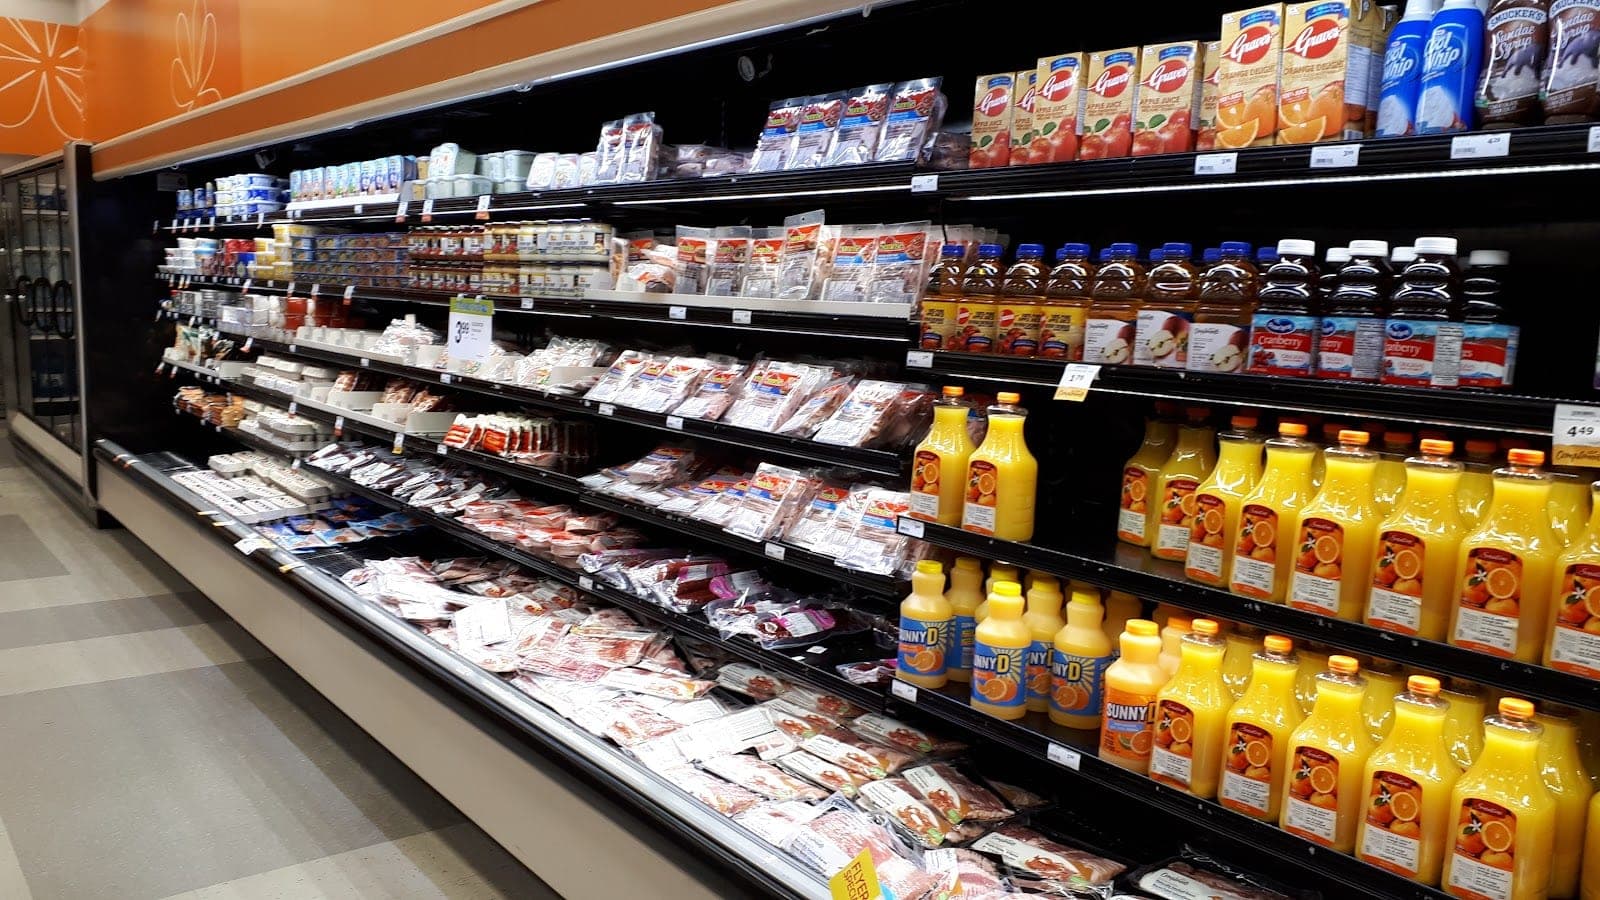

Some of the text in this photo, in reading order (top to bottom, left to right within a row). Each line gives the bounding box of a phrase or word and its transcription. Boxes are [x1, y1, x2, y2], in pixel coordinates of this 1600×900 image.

[1495, 23, 1537, 44] Sundae
[1494, 36, 1533, 60] Syrup
[1257, 335, 1303, 350] Cranberry
